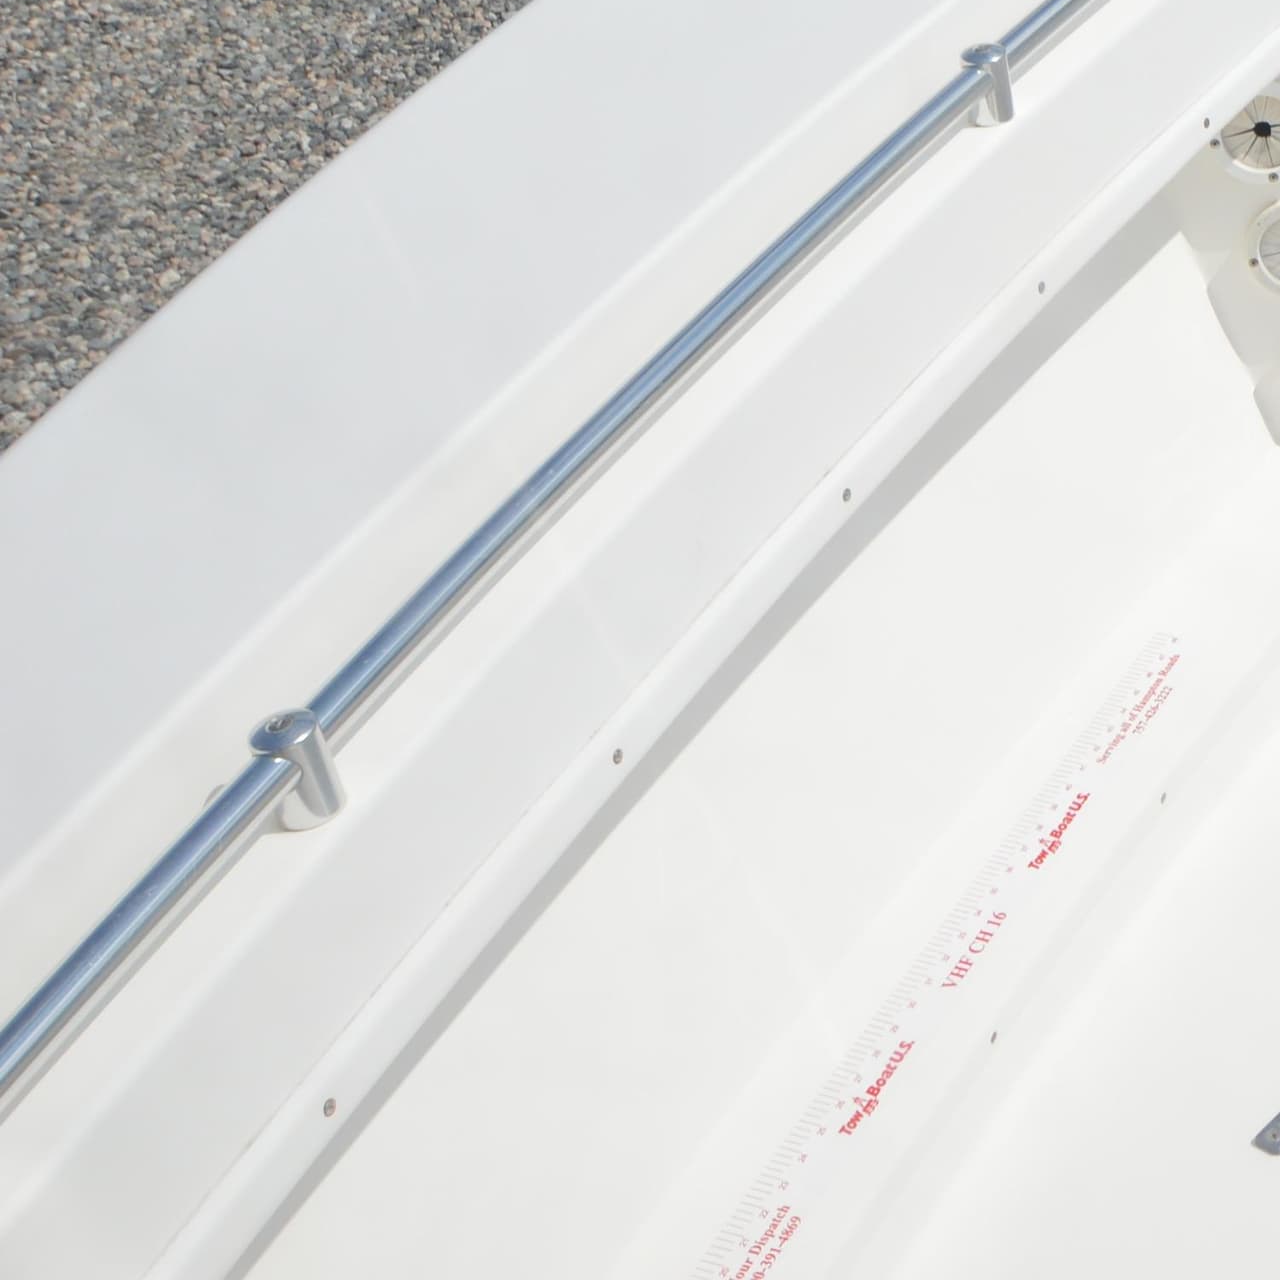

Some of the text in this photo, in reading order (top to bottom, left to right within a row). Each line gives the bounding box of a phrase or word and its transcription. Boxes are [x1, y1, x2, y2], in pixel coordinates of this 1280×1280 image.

[1027, 849, 1049, 870] Tow
[942, 954, 974, 987] VHF
[968, 929, 994, 955] CH
[987, 911, 1007, 927] 16
[838, 1110, 863, 1135] Tow
[748, 1205, 791, 1256] Dispatch
